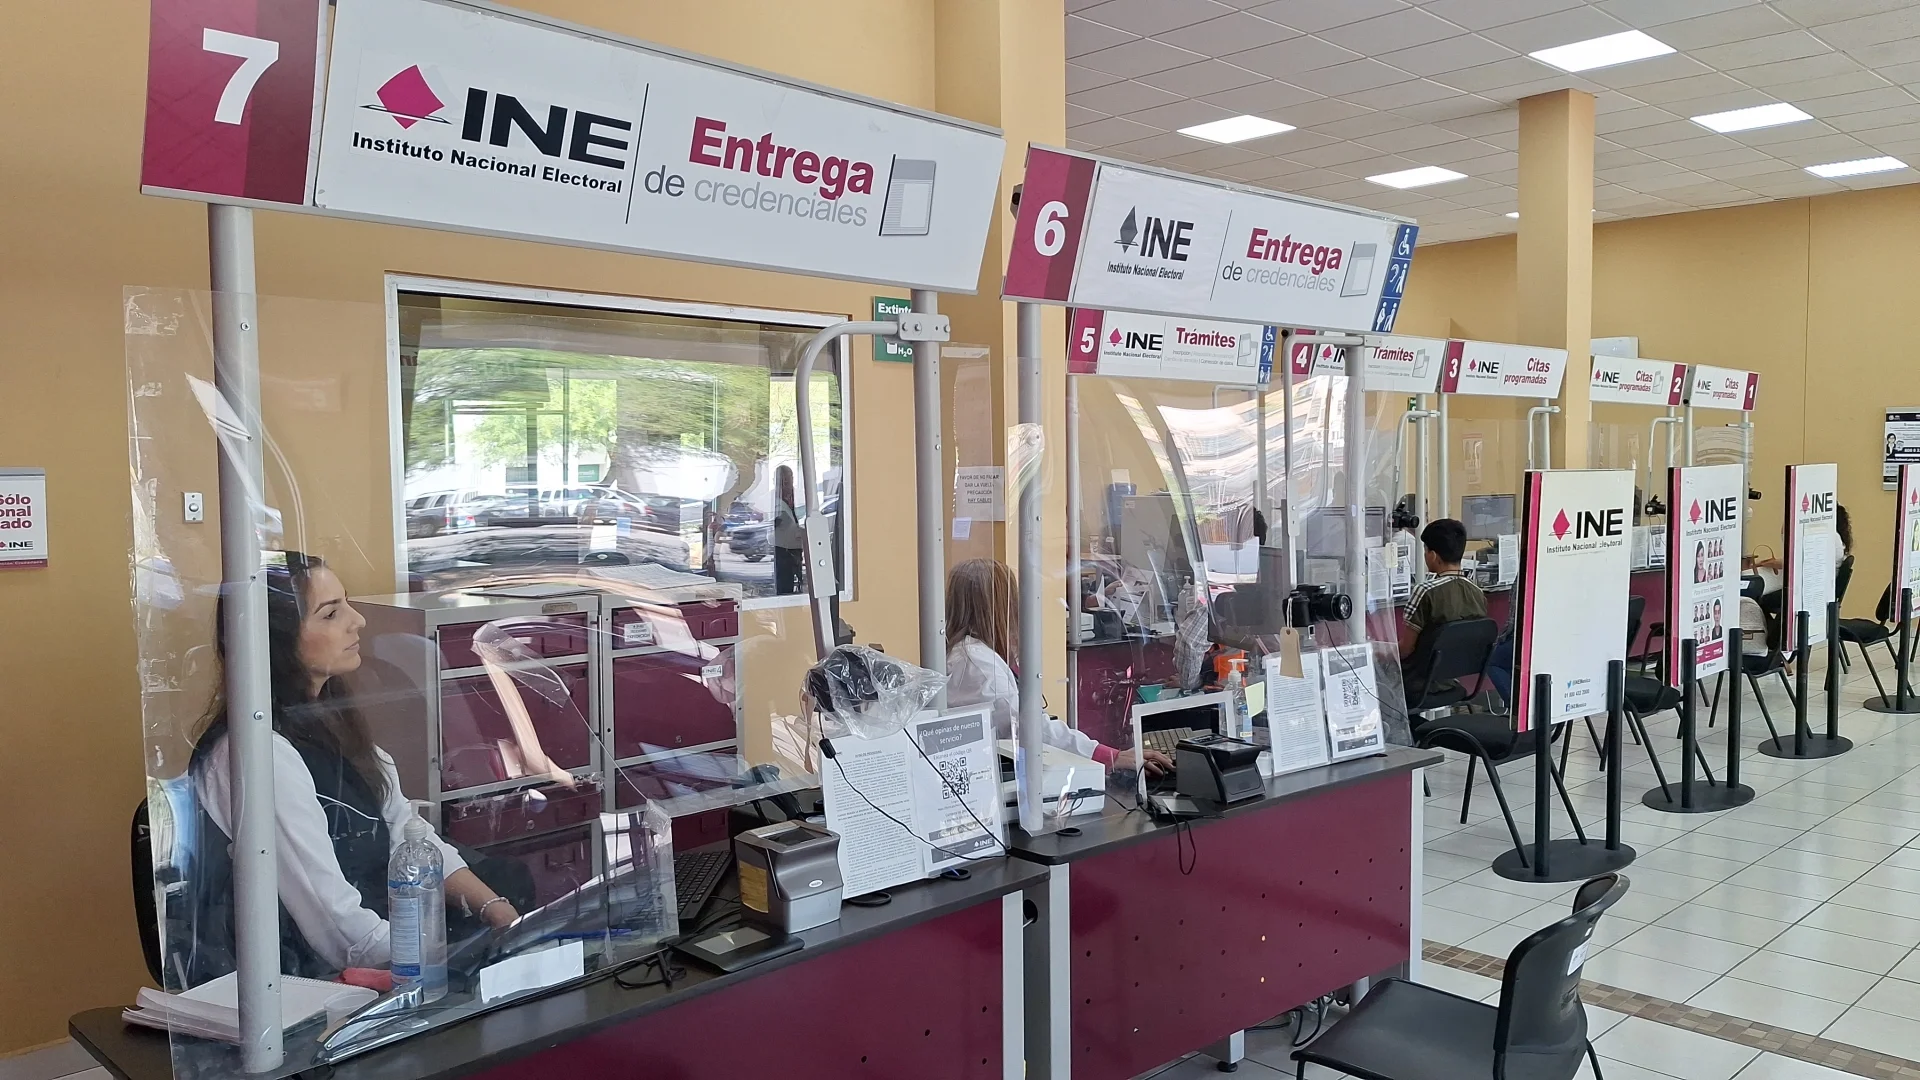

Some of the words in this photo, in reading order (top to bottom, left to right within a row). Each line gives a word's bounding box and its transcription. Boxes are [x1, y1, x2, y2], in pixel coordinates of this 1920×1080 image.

[202, 28, 279, 125] 7
[461, 87, 632, 170] INE
[352, 131, 444, 162] Instituto
[451, 149, 536, 178] Nacional
[542, 166, 622, 193] Electoral
[689, 116, 875, 200] Entrega
[644, 164, 686, 197] de
[694, 178, 868, 227] credenciales
[1034, 200, 1069, 256] 6
[1140, 216, 1194, 262] INE
[1247, 227, 1343, 275] Entrega
[1107, 261, 1132, 275] Instituto
[1132, 264, 1159, 277] Nacional
[1158, 266, 1185, 280] Electoral
[1222, 261, 1243, 281] de
[1246, 269, 1336, 293] credenciales
[878, 302, 911, 314] Extint
[1080, 327, 1096, 354] 5
[1125, 331, 1163, 351] INE
[1176, 327, 1235, 348] Trámites
[1296, 345, 1308, 368] 4
[1333, 348, 1345, 363] IN
[1372, 346, 1414, 362] Trámites
[1449, 358, 1458, 378] 3
[1478, 361, 1500, 374] INE
[1527, 357, 1550, 372] Citas
[1504, 374, 1547, 385] programadas
[1602, 371, 1620, 383] INE
[1636, 370, 1653, 382] Citas
[1673, 376, 1682, 393] 2
[1701, 380, 1712, 390] INE
[1725, 377, 1739, 389] Citas
[1618, 383, 1651, 392] programadas
[1748, 384, 1754, 398] 1
[1705, 497, 1736, 523] INE
[1811, 492, 1833, 514] INE
[1576, 508, 1623, 539] INE
[1546, 544, 1571, 553] Instituto
[1572, 541, 1597, 550] Nacional
[935, 726, 952, 735] opinas
[960, 721, 980, 730] nuestro
[940, 734, 962, 744] servicio?
